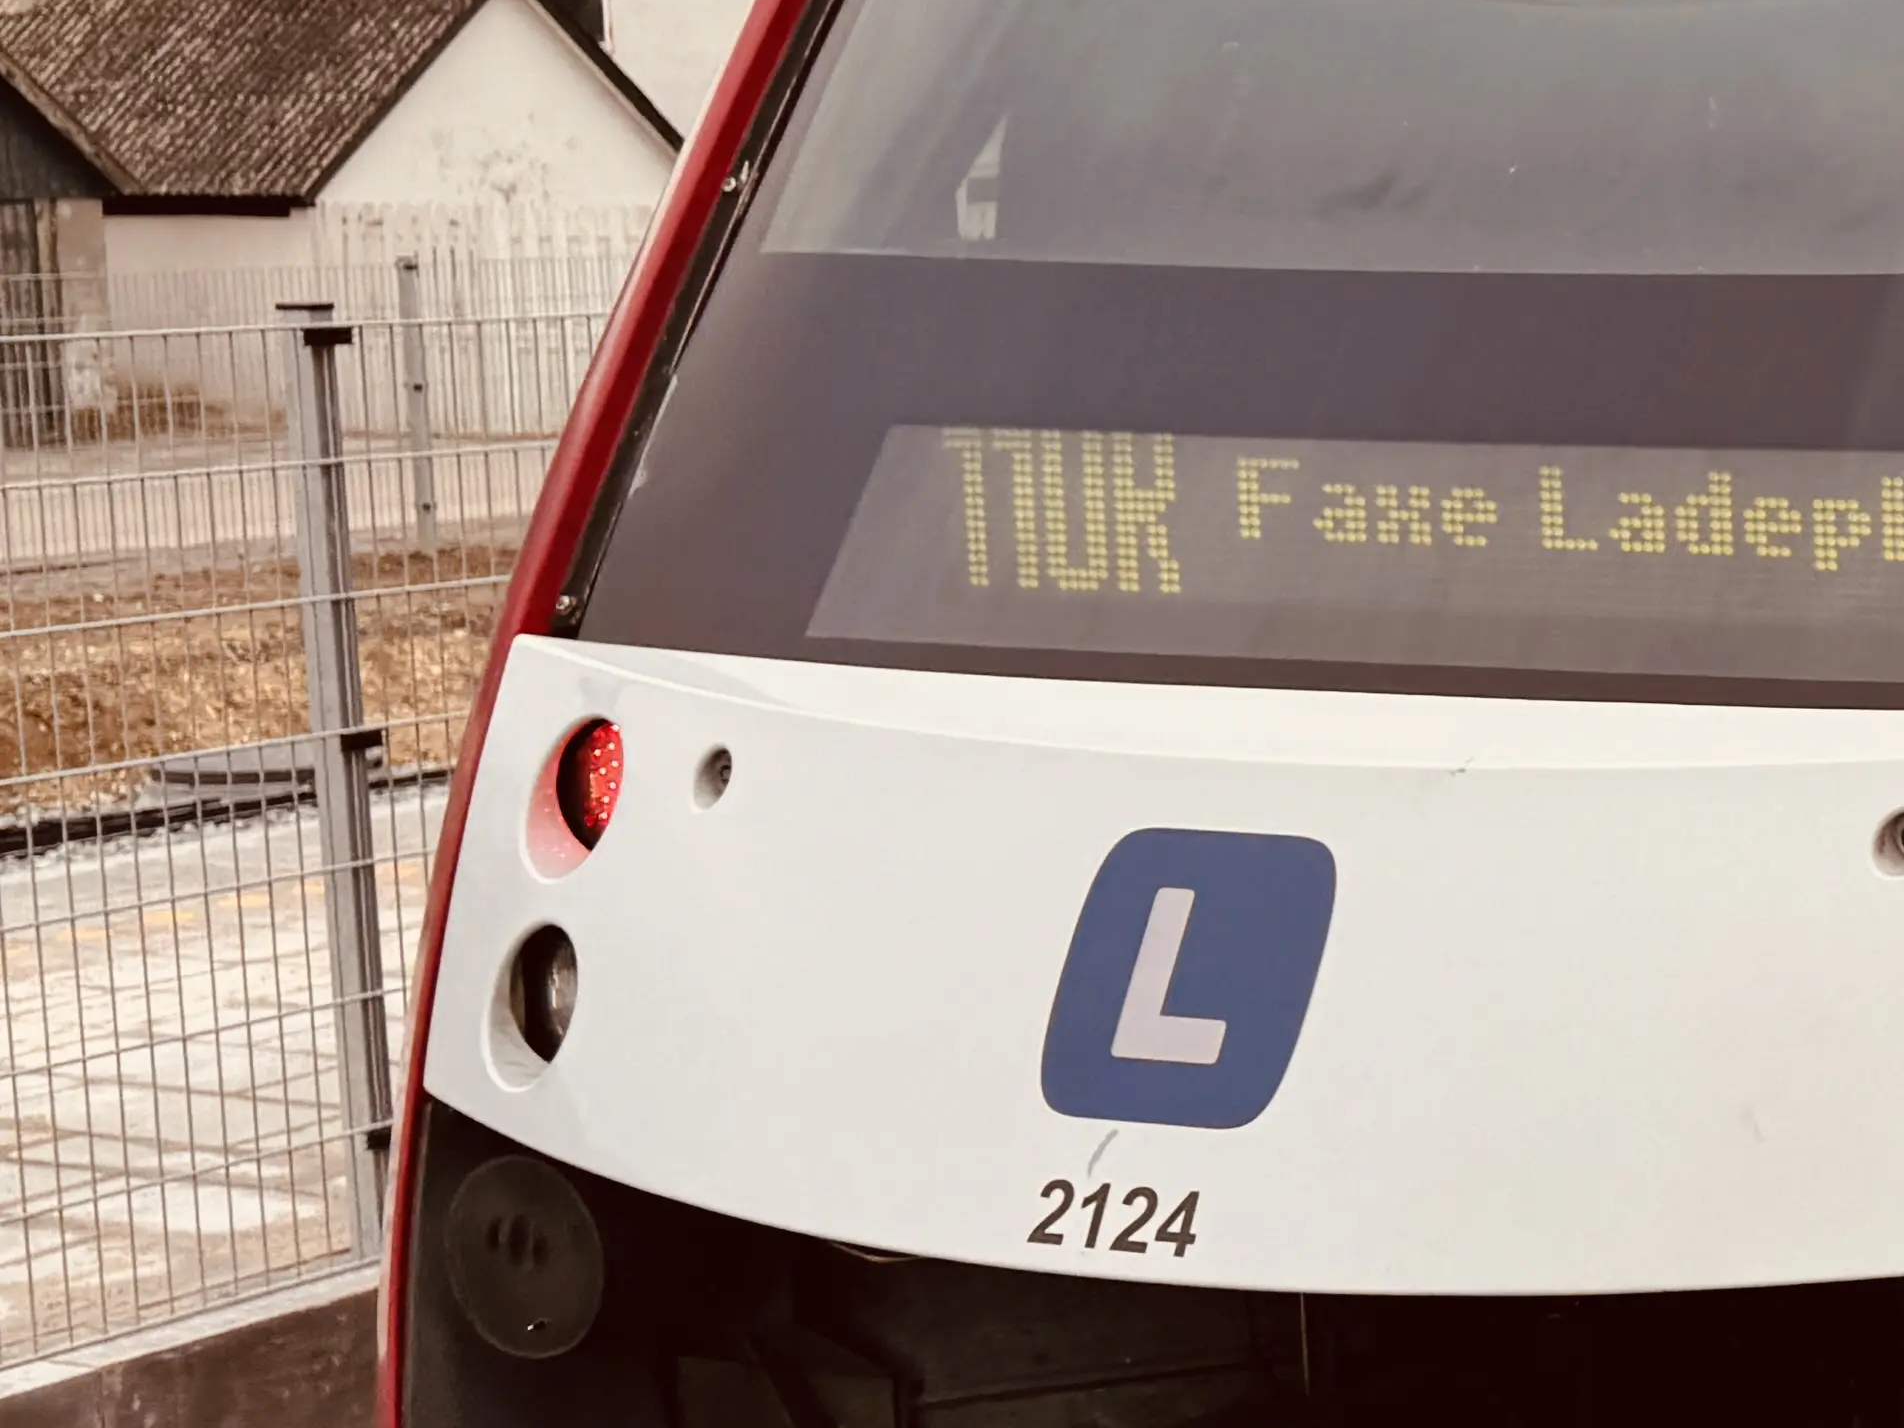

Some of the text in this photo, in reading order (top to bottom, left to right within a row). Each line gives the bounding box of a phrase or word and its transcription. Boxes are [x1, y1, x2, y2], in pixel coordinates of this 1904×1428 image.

[1237, 457, 1497, 546] Faxe
[1110, 886, 1228, 1065] L
[1027, 1179, 1201, 1258] 2124
